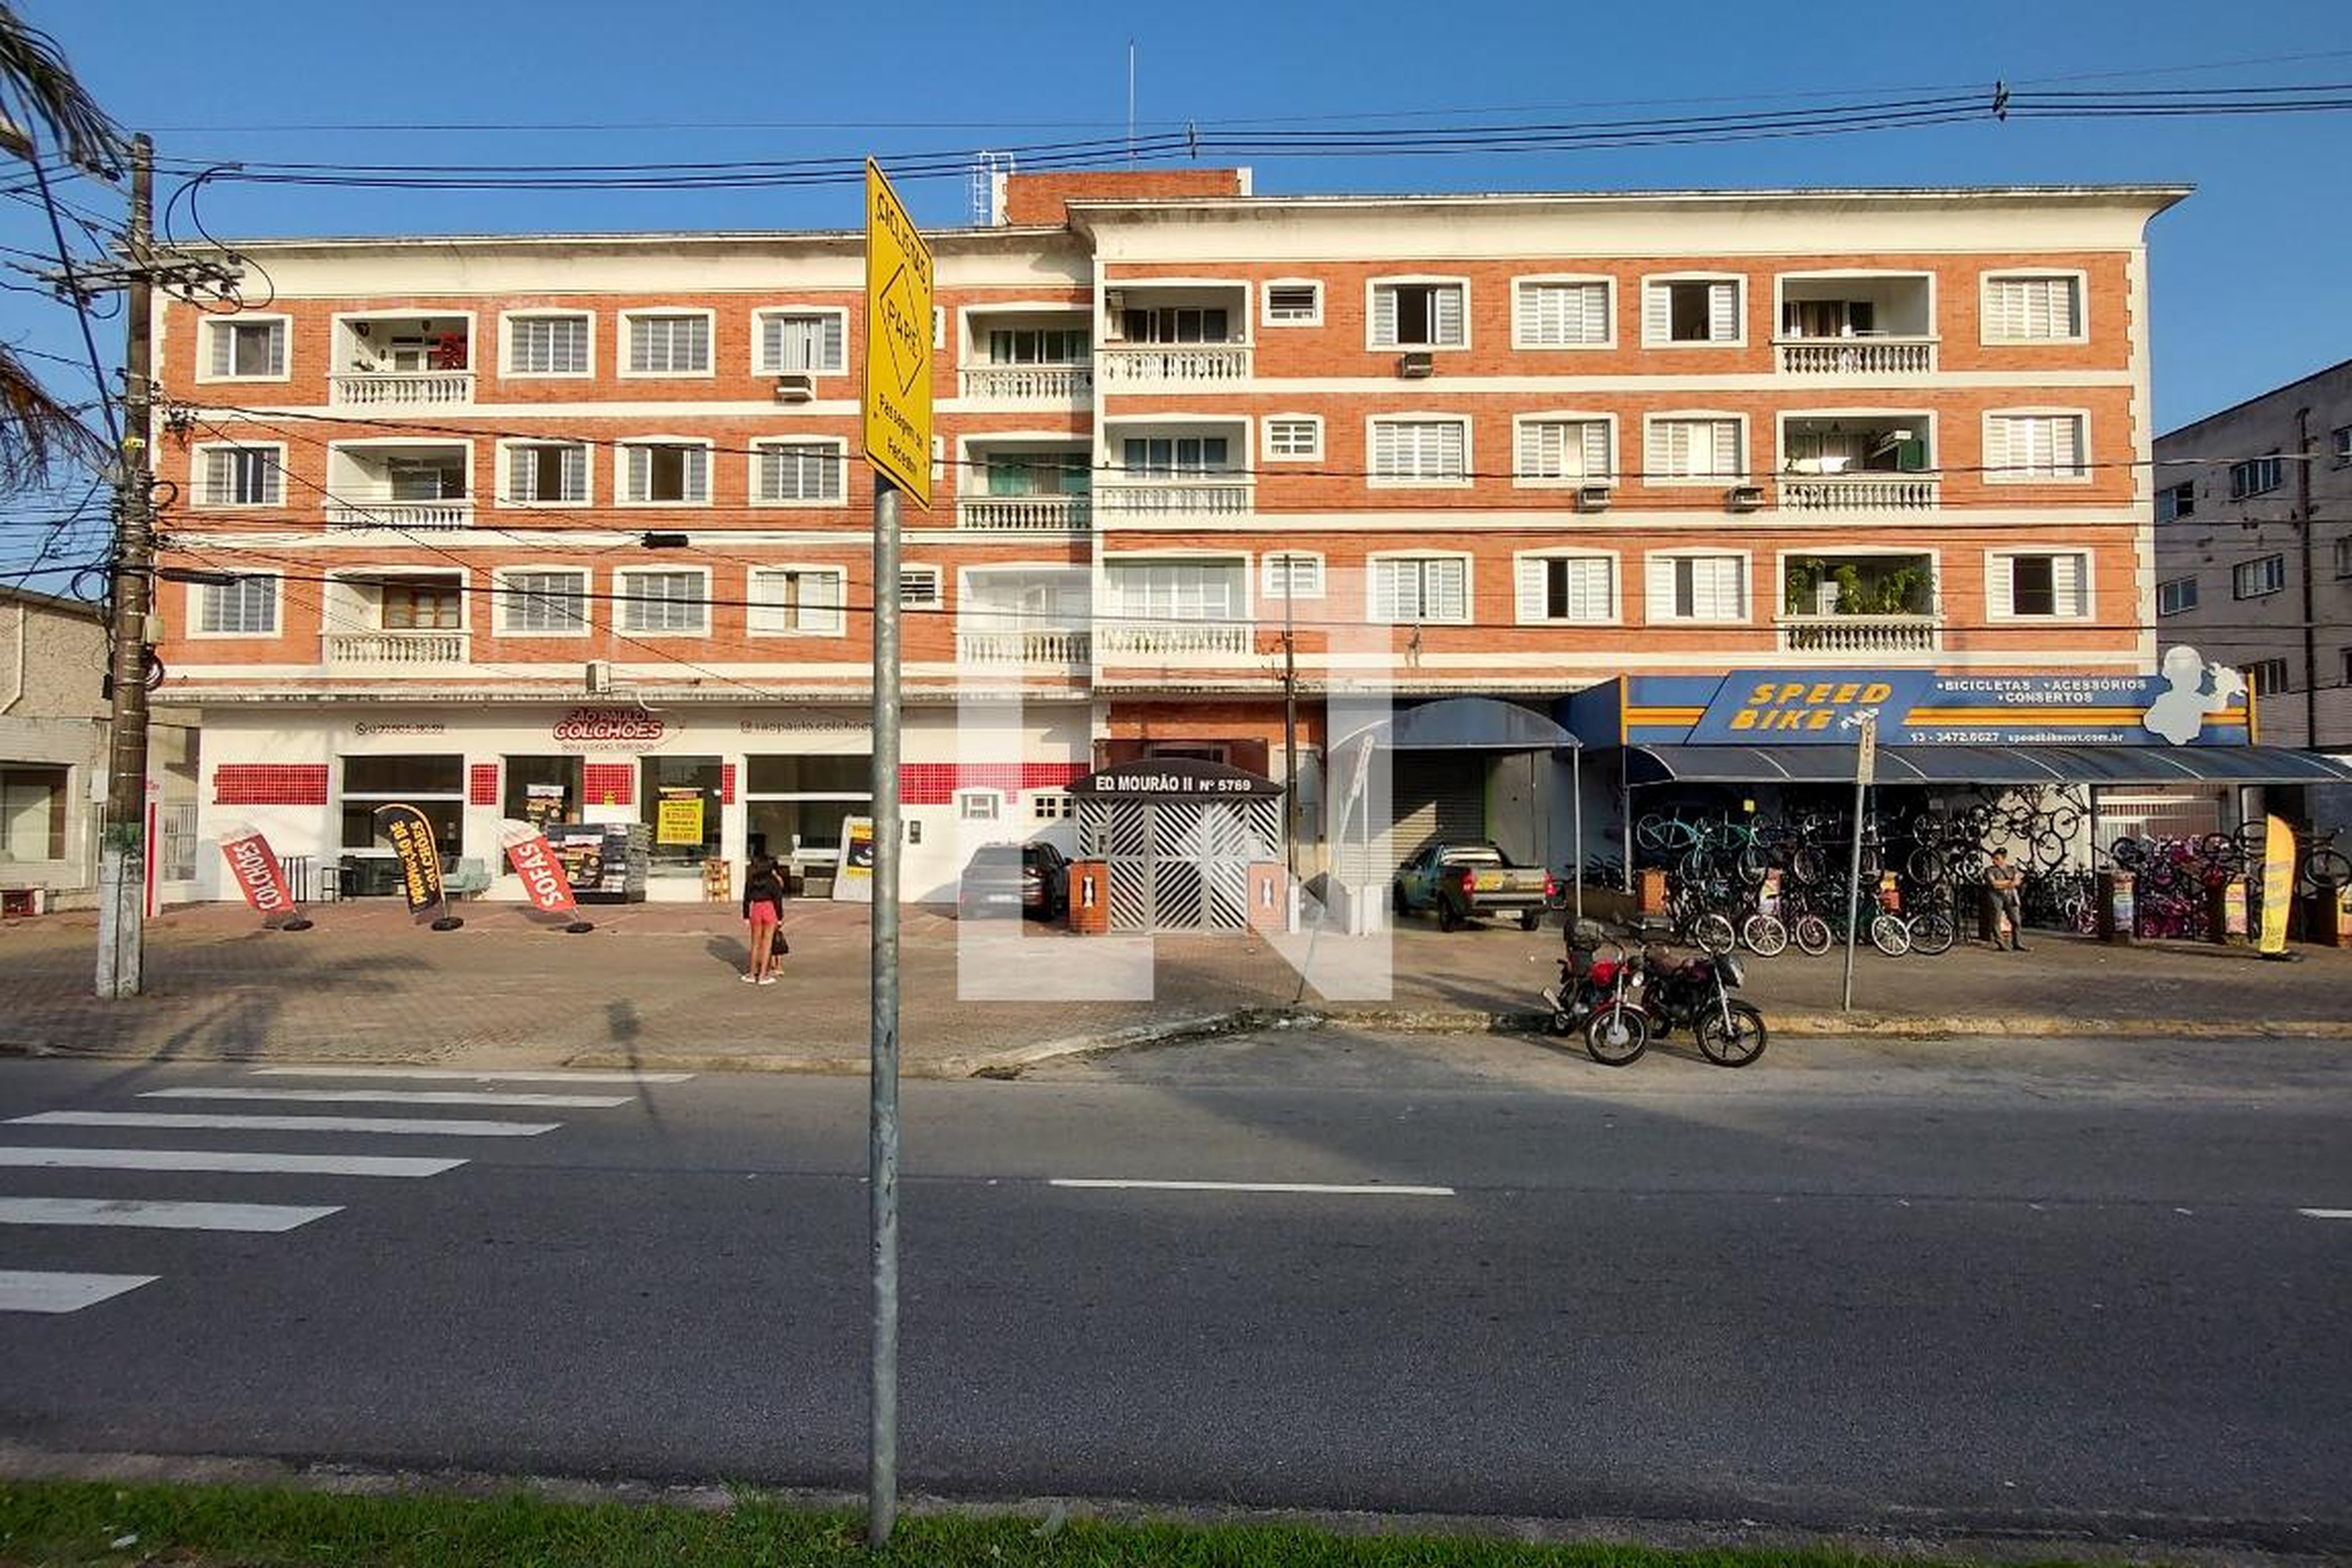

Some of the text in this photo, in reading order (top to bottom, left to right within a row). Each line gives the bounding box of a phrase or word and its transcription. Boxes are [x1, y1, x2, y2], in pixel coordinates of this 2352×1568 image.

[888, 298, 918, 359] PARE
[1748, 683, 1891, 704] SPEED
[2005, 692, 2093, 703] CONSERTOS
[600, 707, 648, 723] PAULO
[1730, 709, 1835, 730] BIKE
[1118, 774, 1180, 791] MOURÃO
[1183, 776, 1193, 791] II
[1218, 779, 1251, 791] 5769
[390, 820, 409, 840] DE
